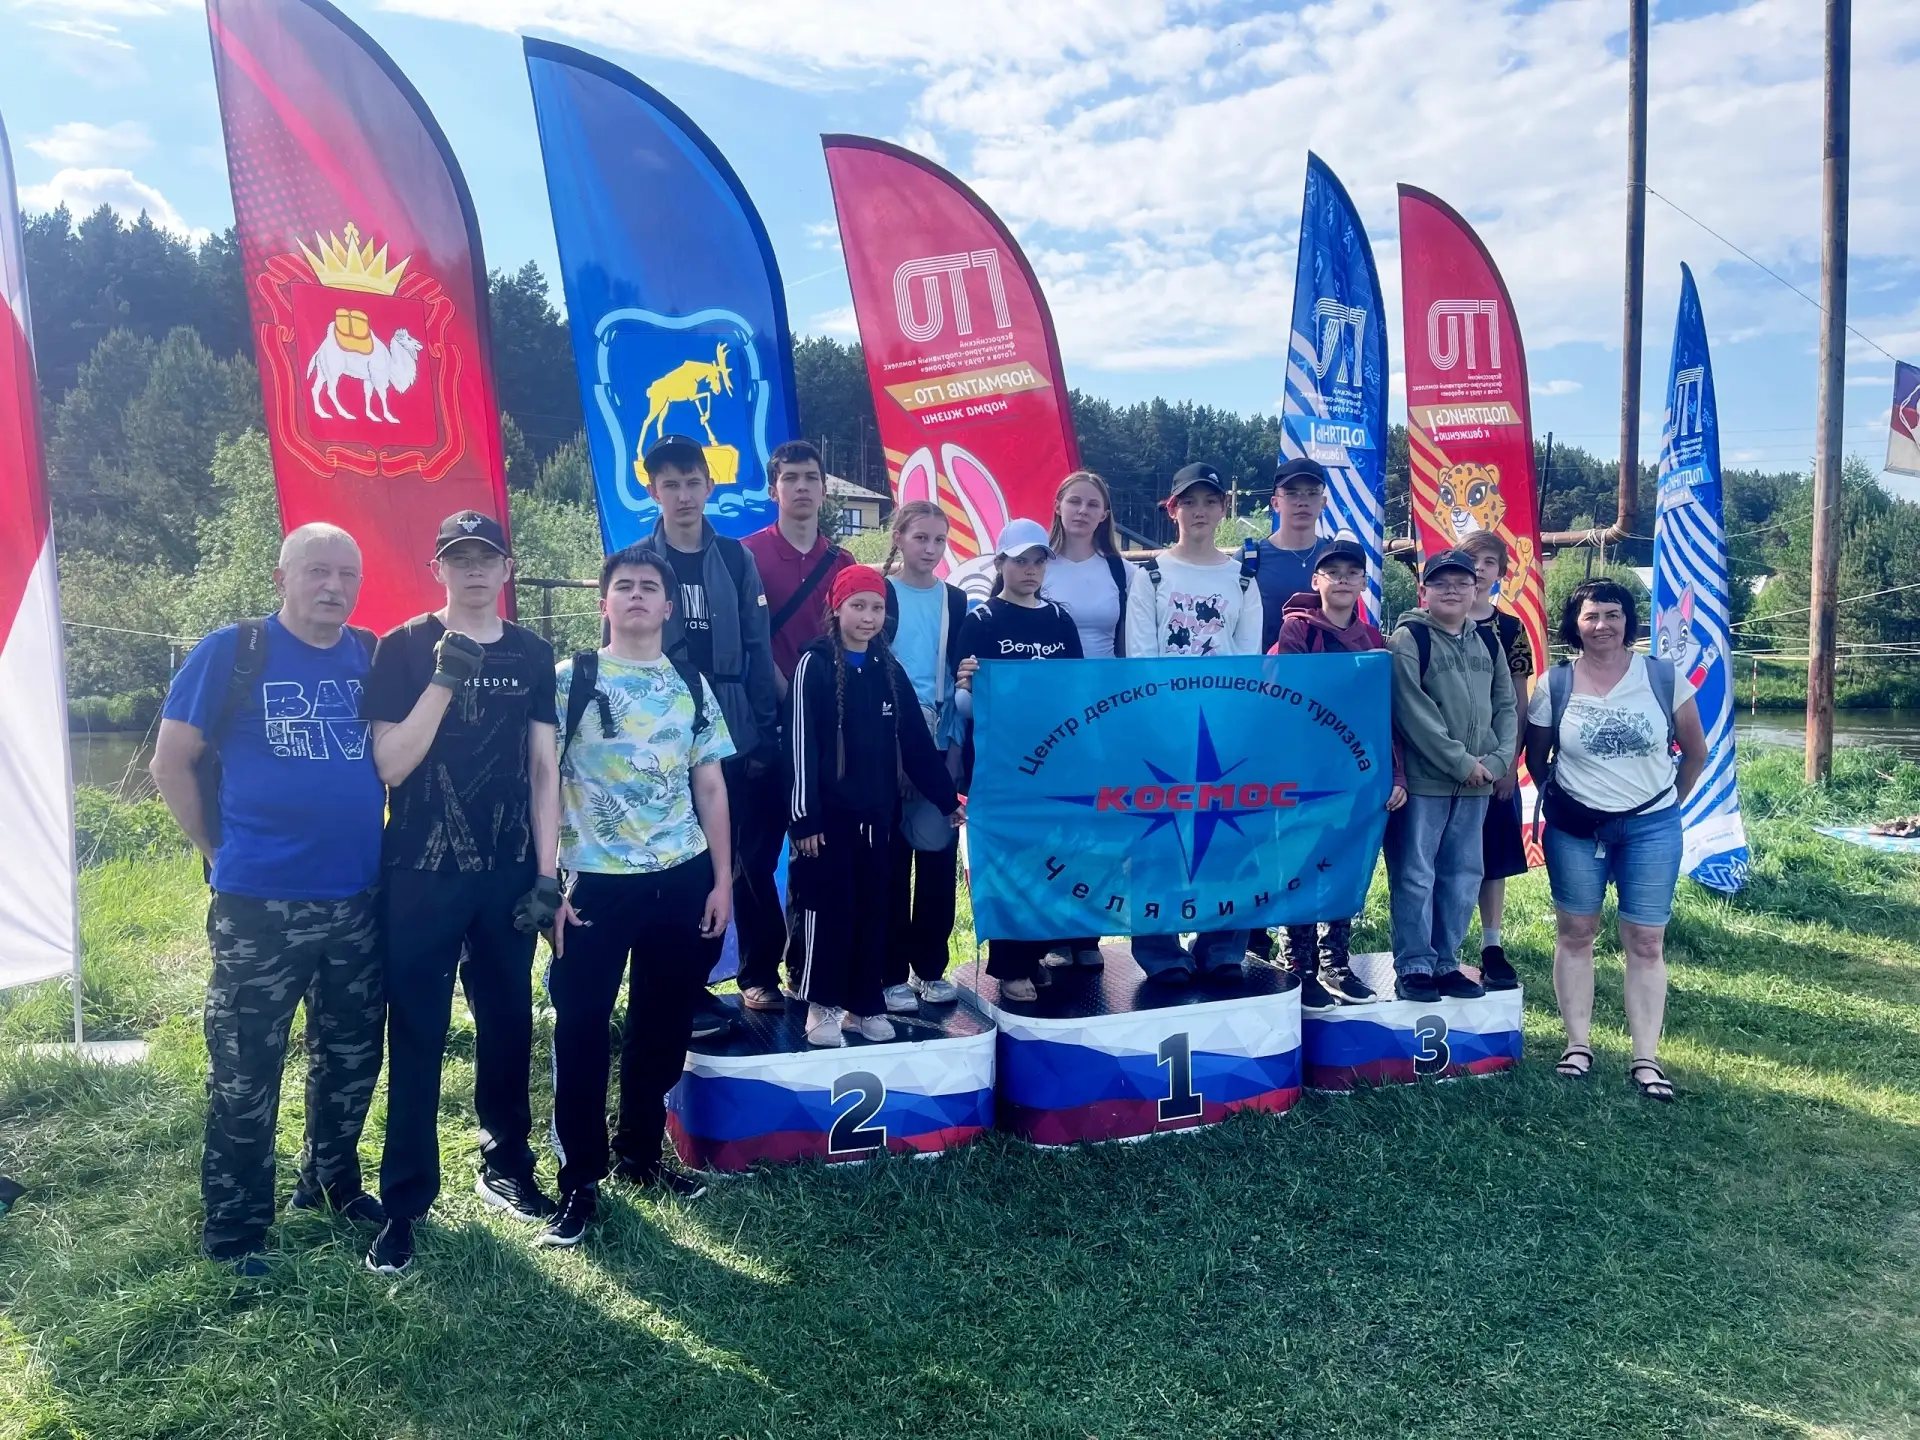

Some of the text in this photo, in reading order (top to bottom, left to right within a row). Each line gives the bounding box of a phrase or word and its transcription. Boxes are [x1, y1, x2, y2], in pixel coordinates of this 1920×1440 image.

[997, 638, 1066, 659] Bonjour
[1018, 673, 1372, 777] Центр детско-юношеского туризма
[1095, 782, 1300, 812] КОСМОС
[1044, 854, 1334, 920] Челябинск
[1156, 1031, 1203, 1123] 1
[1412, 1015, 1451, 1075] 3
[828, 1071, 888, 1156] 2
